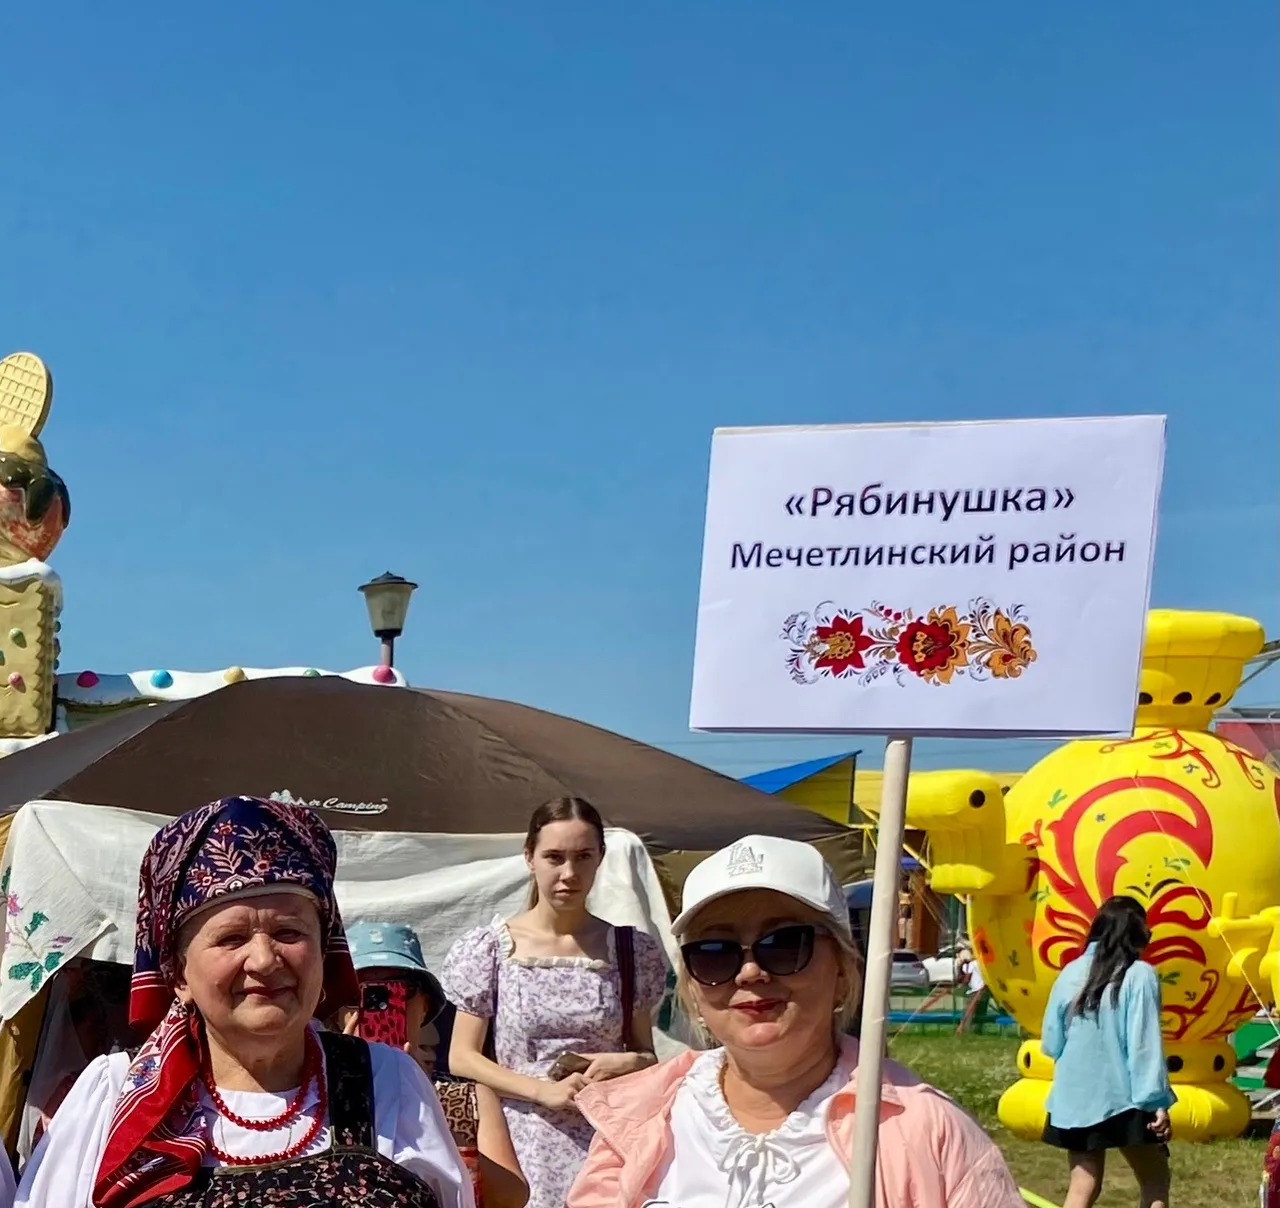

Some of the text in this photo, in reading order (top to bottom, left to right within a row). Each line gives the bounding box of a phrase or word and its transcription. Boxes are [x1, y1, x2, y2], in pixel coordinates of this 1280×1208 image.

[784, 483, 1076, 521] «Рябинушка»
[730, 534, 1126, 570] Мечетлинский район
[322, 798, 388, 814] Camping
